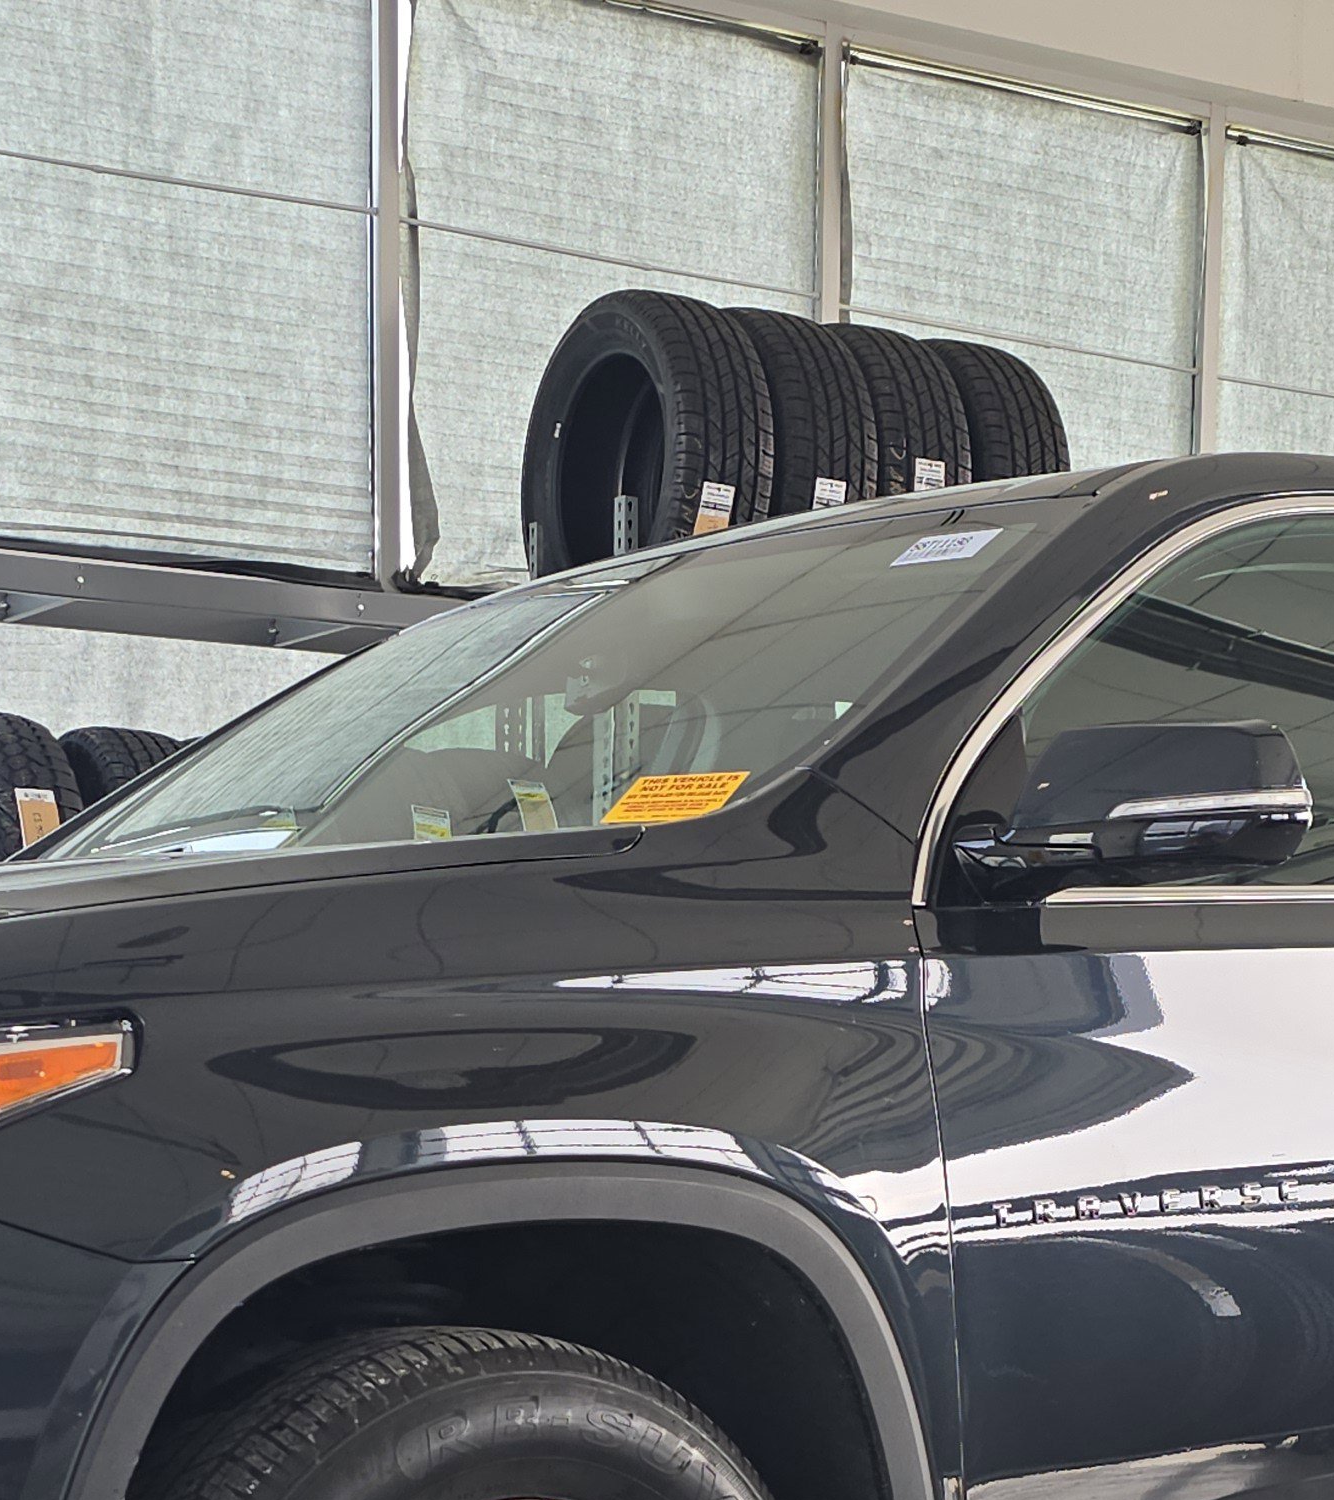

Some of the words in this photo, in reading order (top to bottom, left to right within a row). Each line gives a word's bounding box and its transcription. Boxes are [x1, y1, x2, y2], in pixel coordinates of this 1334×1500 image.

[641, 778, 668, 786] THIS
[673, 775, 723, 784] VEHICLE
[727, 774, 741, 782] IS
[640, 784, 663, 792] NOT
[668, 783, 693, 791] FOR
[696, 781, 729, 790] SALE
[991, 1178, 1299, 1227] TRAVERSE
